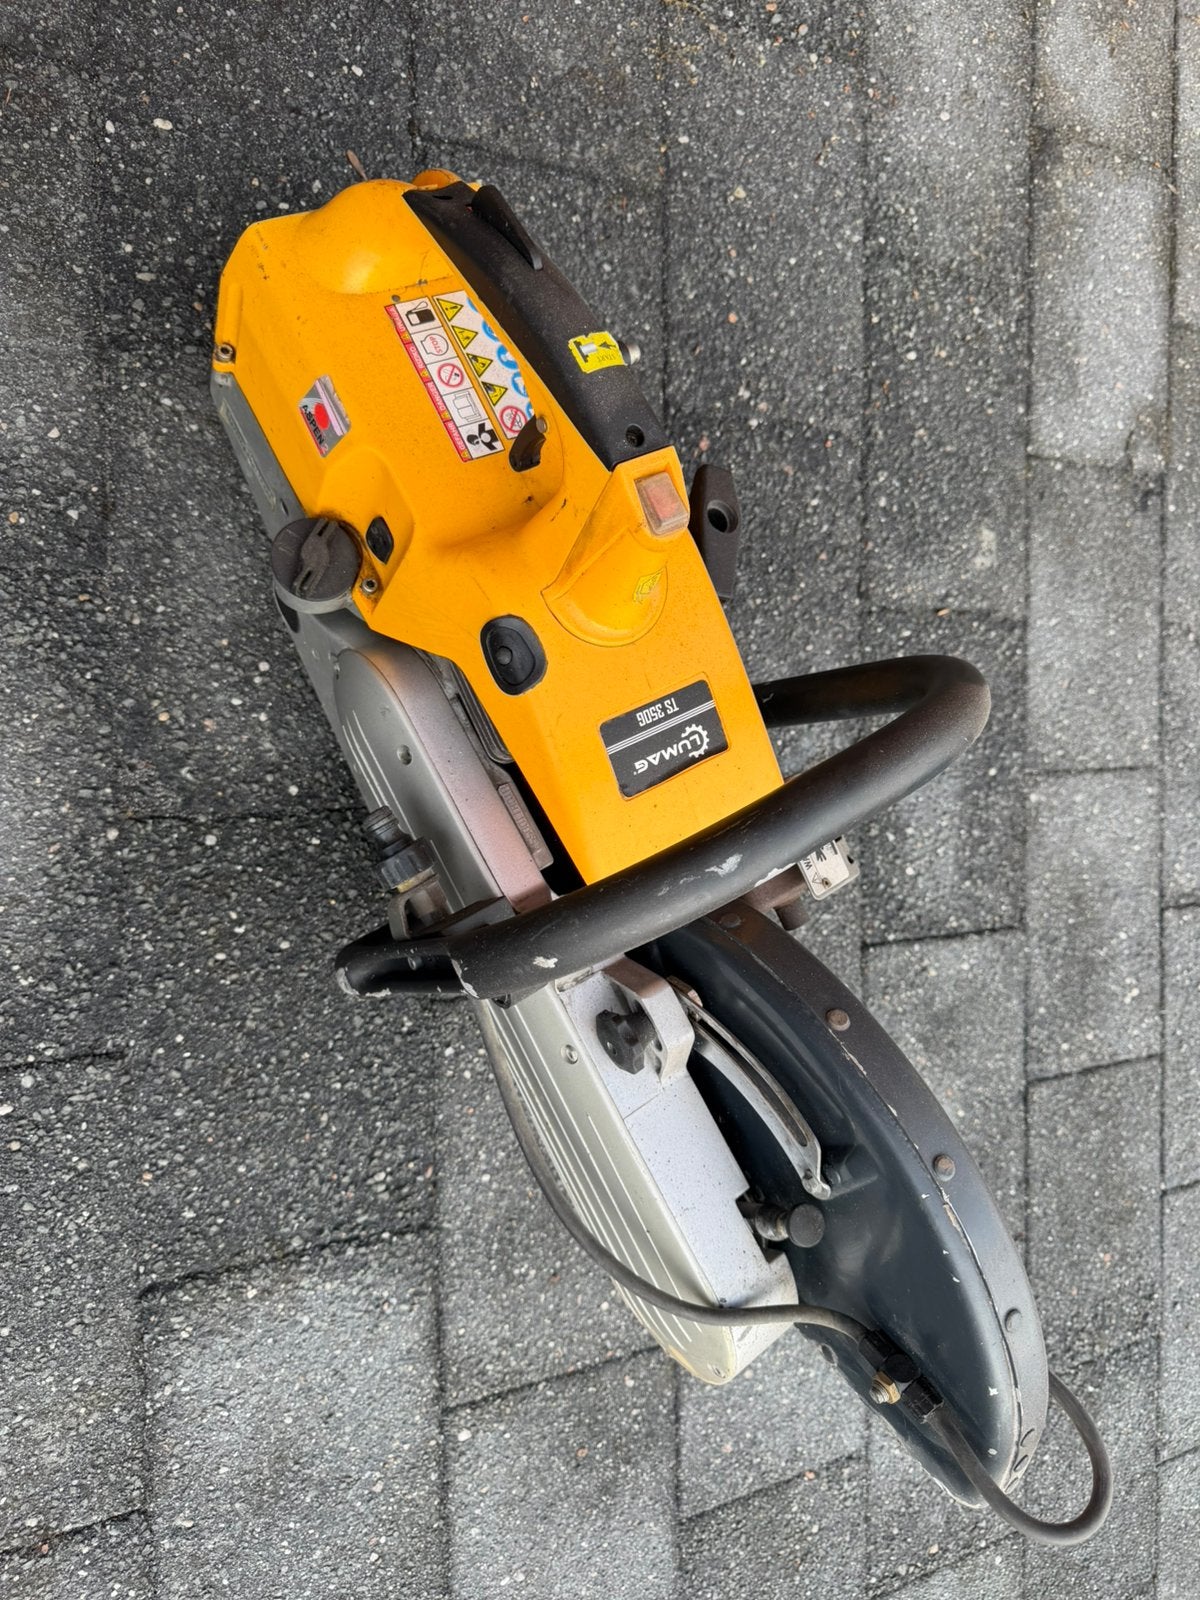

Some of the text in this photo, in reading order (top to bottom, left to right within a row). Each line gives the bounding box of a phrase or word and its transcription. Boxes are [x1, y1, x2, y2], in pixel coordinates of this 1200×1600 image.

[429, 335, 443, 354] STOP
[426, 381, 446, 412] DANGER
[302, 404, 325, 445] ASPEN
[447, 422, 467, 451] GEFAHR
[635, 697, 680, 727] TS 350G
[634, 733, 702, 774] LUMAG
